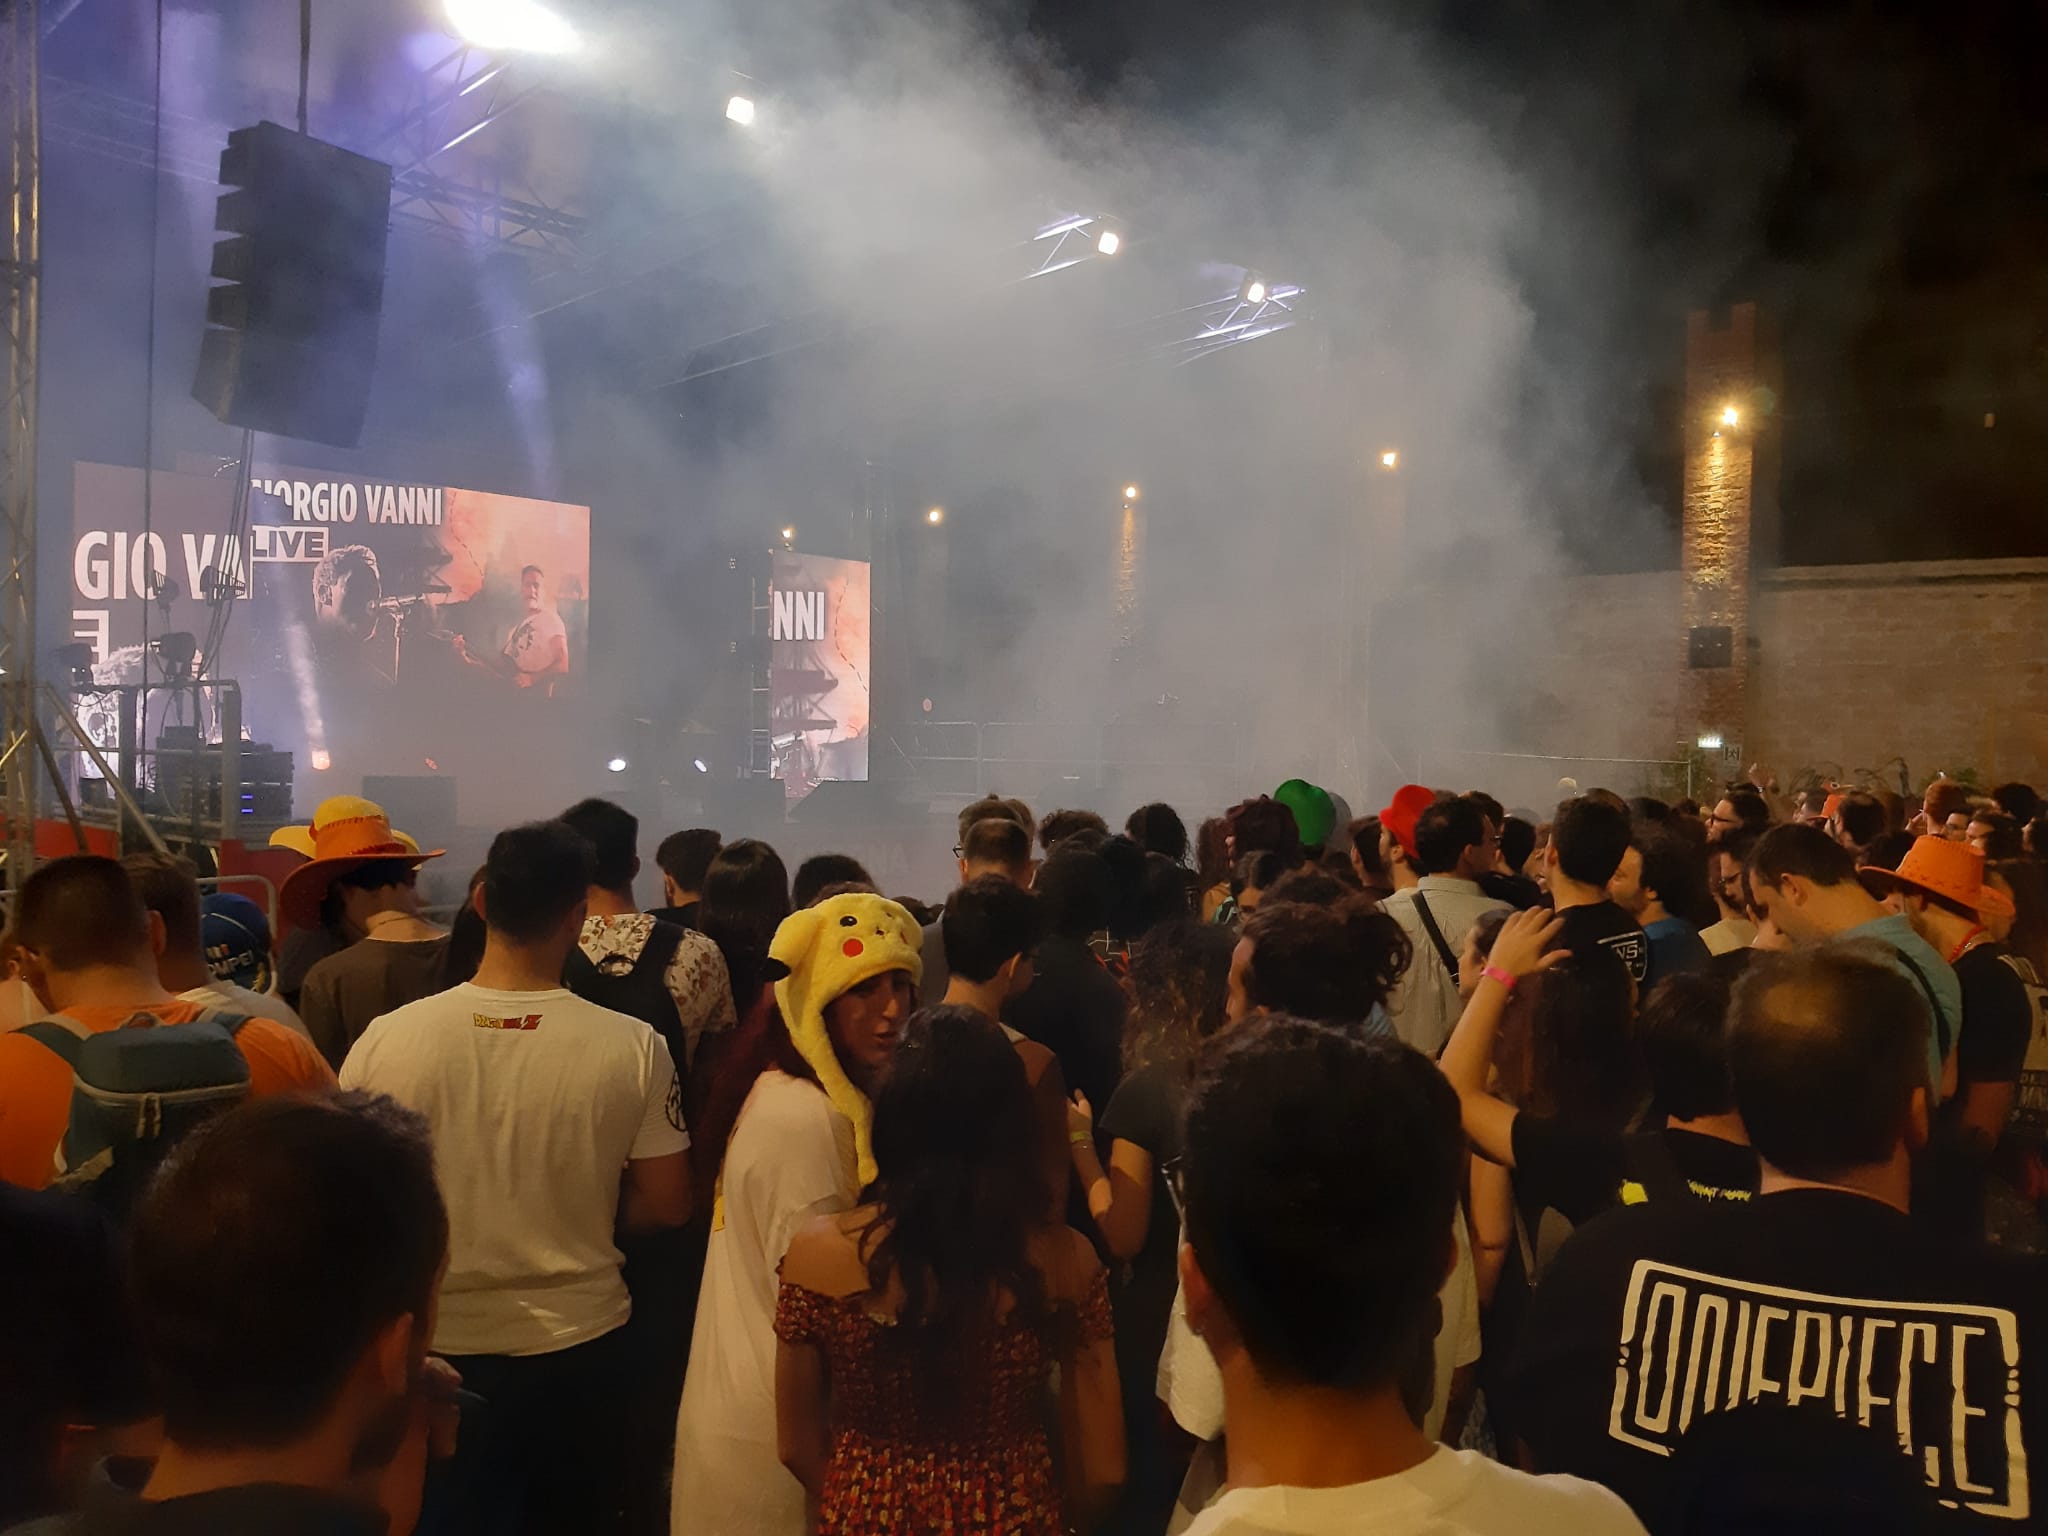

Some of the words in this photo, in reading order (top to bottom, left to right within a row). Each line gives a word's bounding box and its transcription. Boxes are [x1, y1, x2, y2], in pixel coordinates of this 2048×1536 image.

[364, 484, 442, 526] VANNI
[74, 531, 167, 600] GIO
[252, 530, 324, 558] LIVE
[773, 591, 825, 641] NNI
